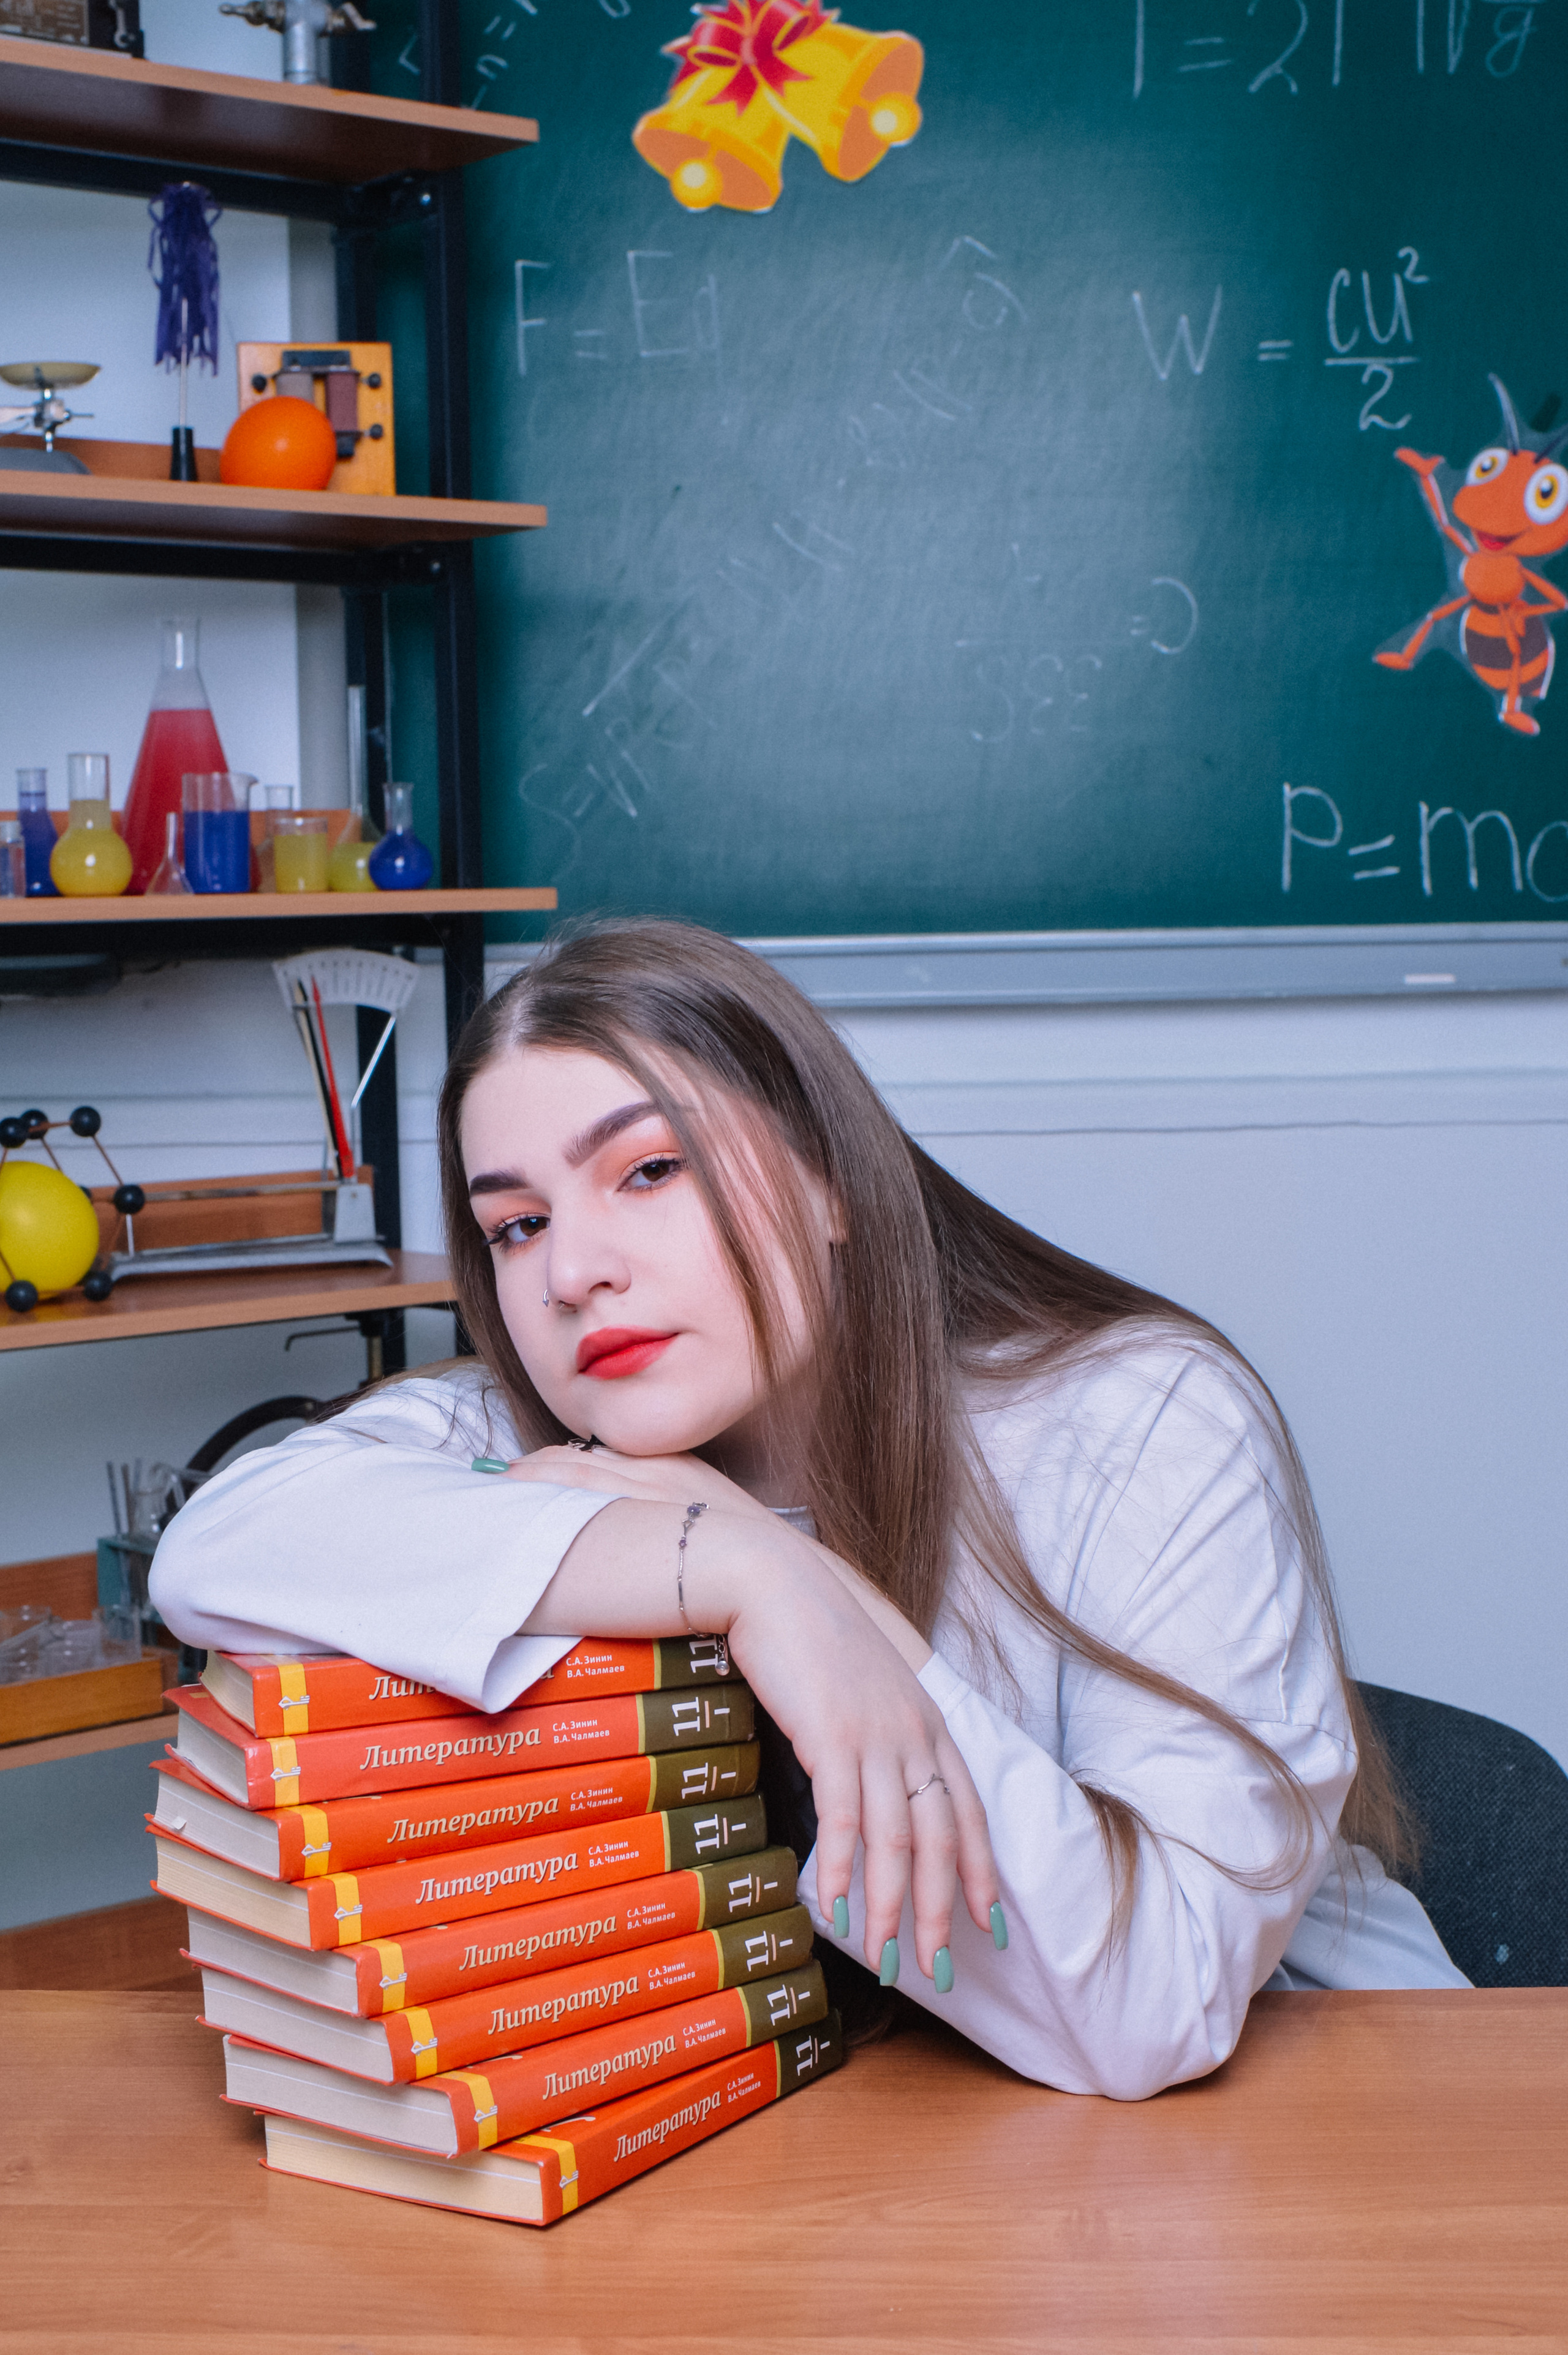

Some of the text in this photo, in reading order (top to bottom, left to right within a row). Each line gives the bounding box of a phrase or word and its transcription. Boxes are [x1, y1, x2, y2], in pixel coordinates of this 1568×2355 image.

[584, 1655, 612, 1664] Зинин
[585, 1665, 625, 1675] Чалмаев
[570, 1719, 598, 1729] Зинин
[672, 1697, 700, 1736] 11
[571, 1730, 609, 1740] Чалмаев
[360, 1728, 541, 1769] Литература
[587, 1788, 612, 1798] Зинин
[681, 1762, 708, 1799] 11
[587, 1796, 622, 1807] Чалмаев
[387, 1798, 559, 1843] Литература
[604, 1841, 628, 1852] Зинин
[694, 1814, 720, 1854] 11
[605, 1850, 639, 1863] Чалмаев
[415, 1853, 578, 1904] Литература
[728, 1873, 752, 1913] 11
[642, 1903, 666, 1914] Зинин
[643, 1912, 675, 1926] Чалмаев
[459, 1916, 616, 1970] Литература
[745, 1931, 769, 1972] 11
[663, 1962, 685, 1974] Зинин
[664, 1972, 695, 1986] Чалмаев
[488, 1976, 639, 2035] Литература
[767, 1984, 790, 2026] 11
[696, 2019, 716, 2032] Зинин
[698, 2028, 726, 2043] Чалмаев
[543, 2035, 676, 2100] Литература
[796, 2035, 813, 2076] 11
[614, 2091, 721, 2161] Литература
